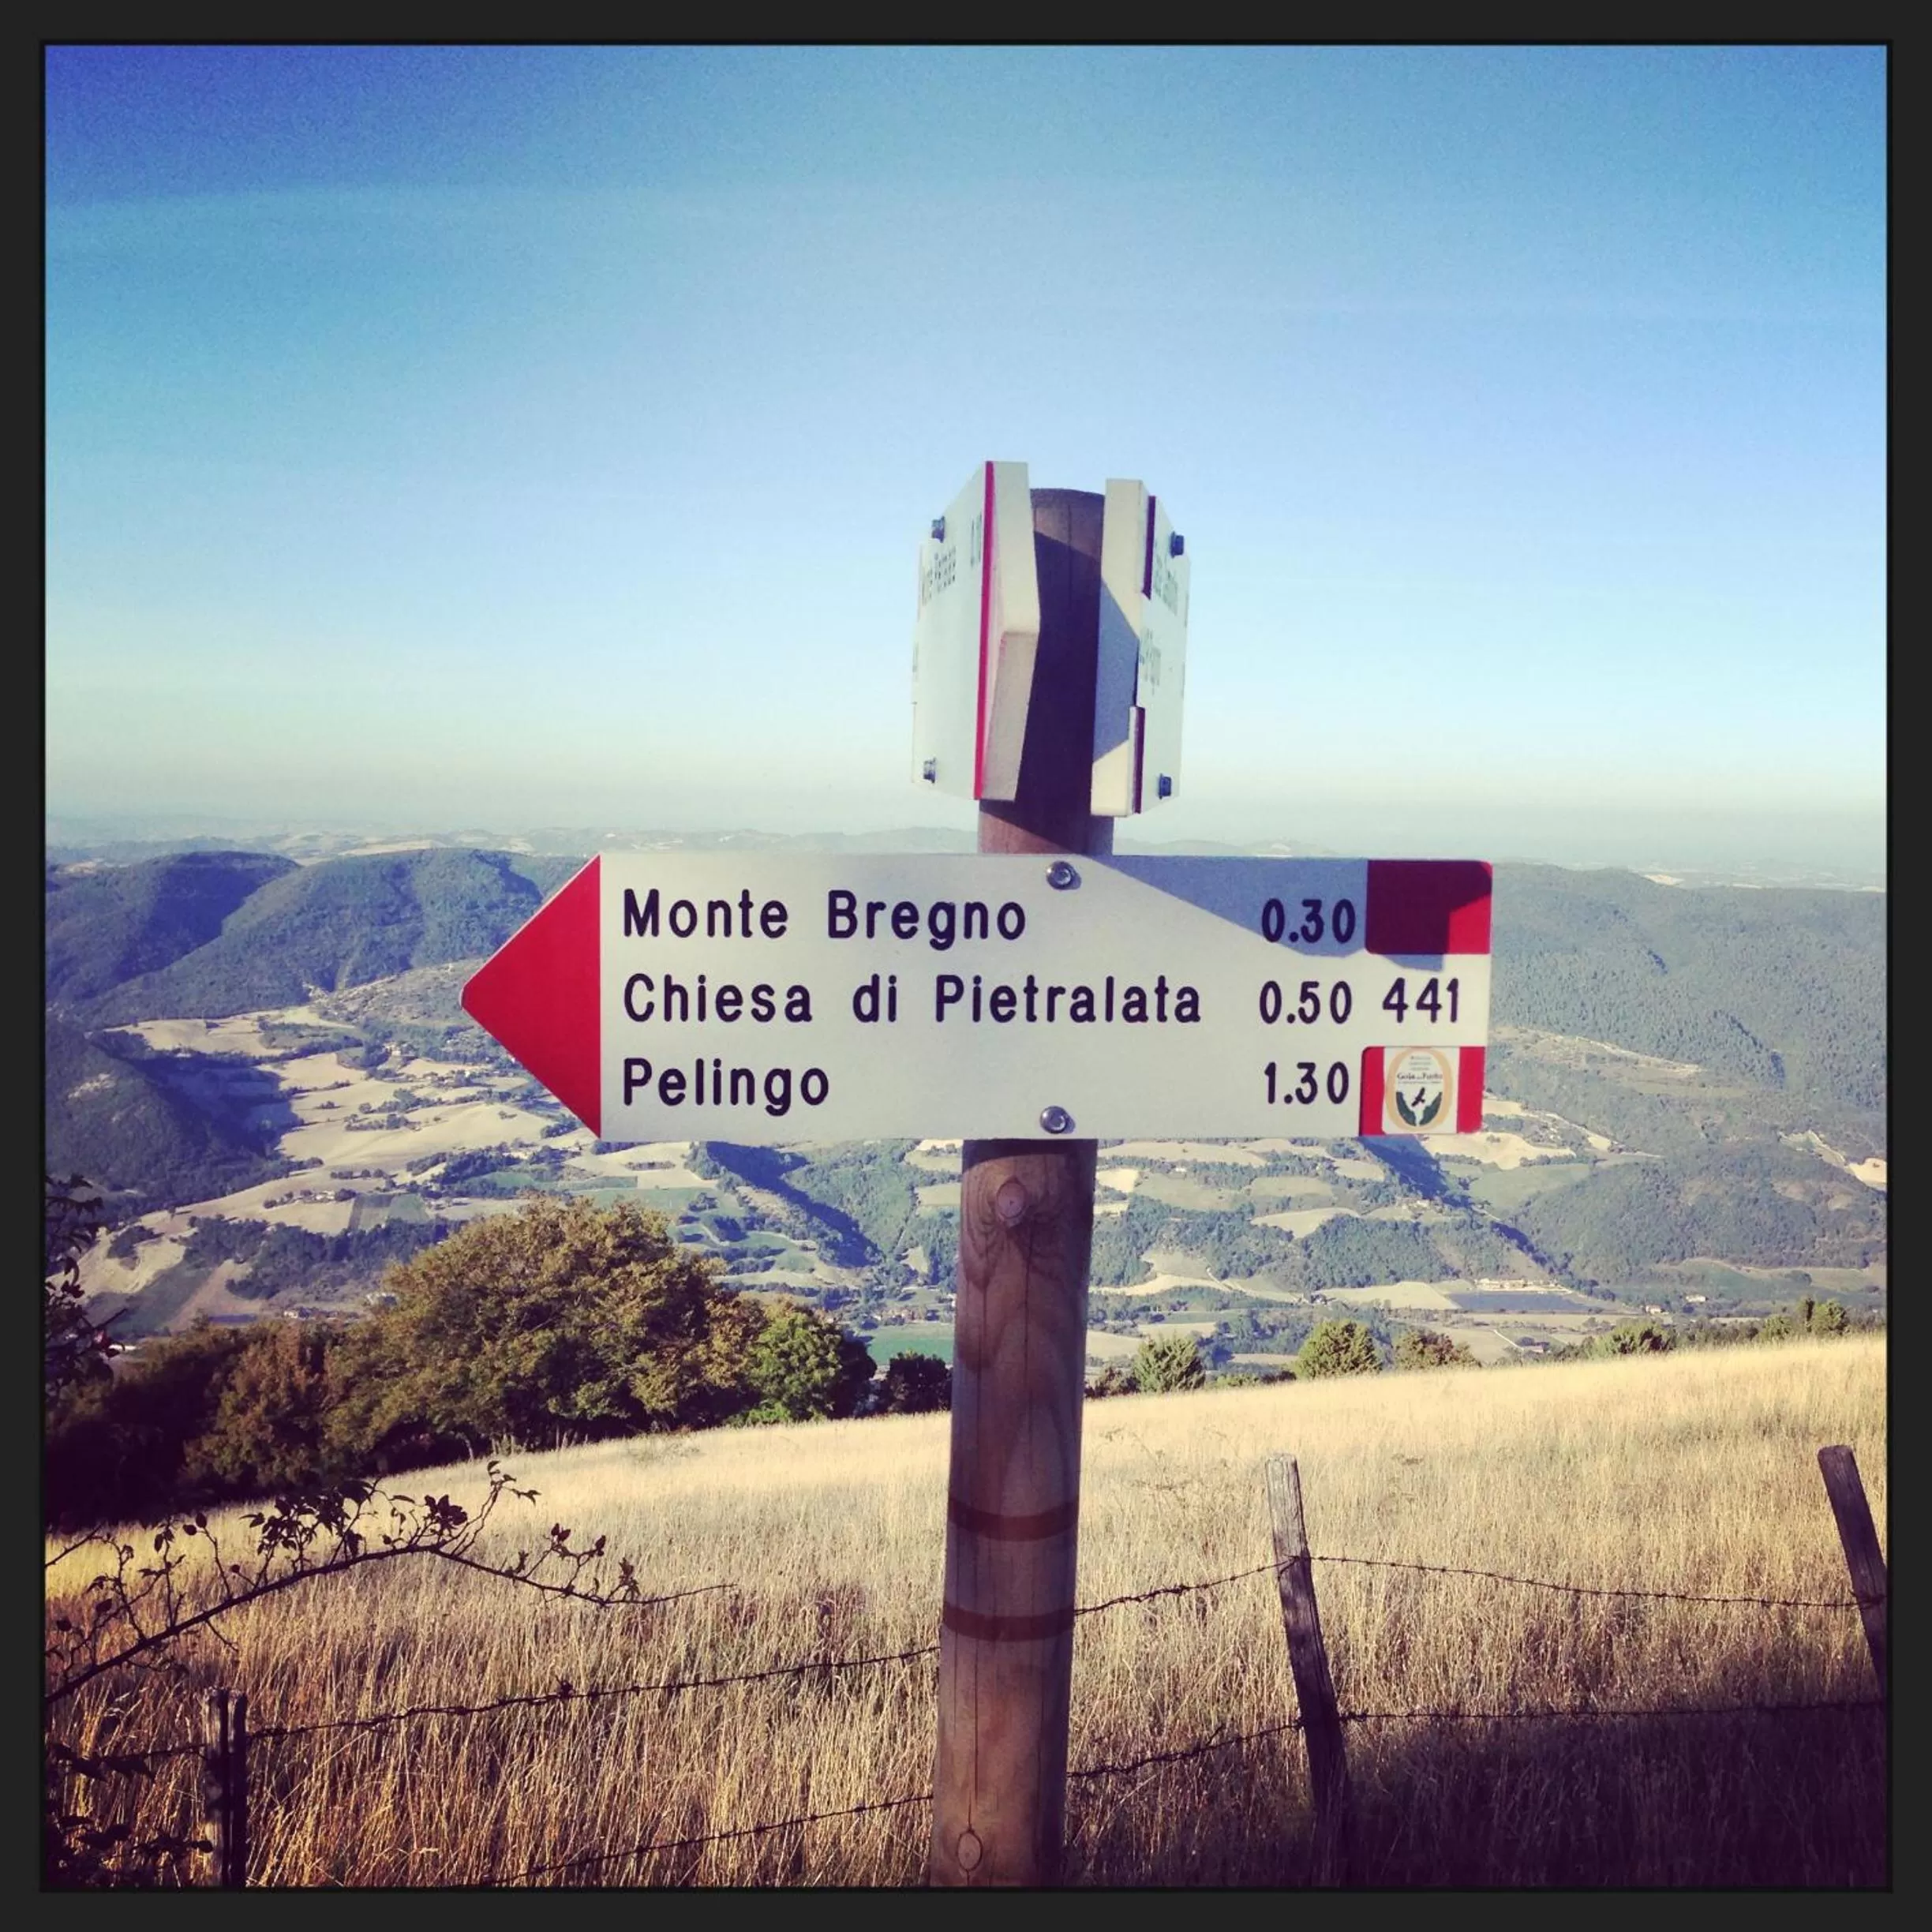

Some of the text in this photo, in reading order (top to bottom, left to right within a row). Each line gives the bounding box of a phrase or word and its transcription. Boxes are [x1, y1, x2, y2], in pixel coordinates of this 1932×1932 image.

[623, 888, 1357, 952] Monte Bregno 0.30
[623, 972, 1460, 1024] Chiesa di Pietralata 0.50 441
[623, 1057, 1350, 1118] Pelingo 1.30
